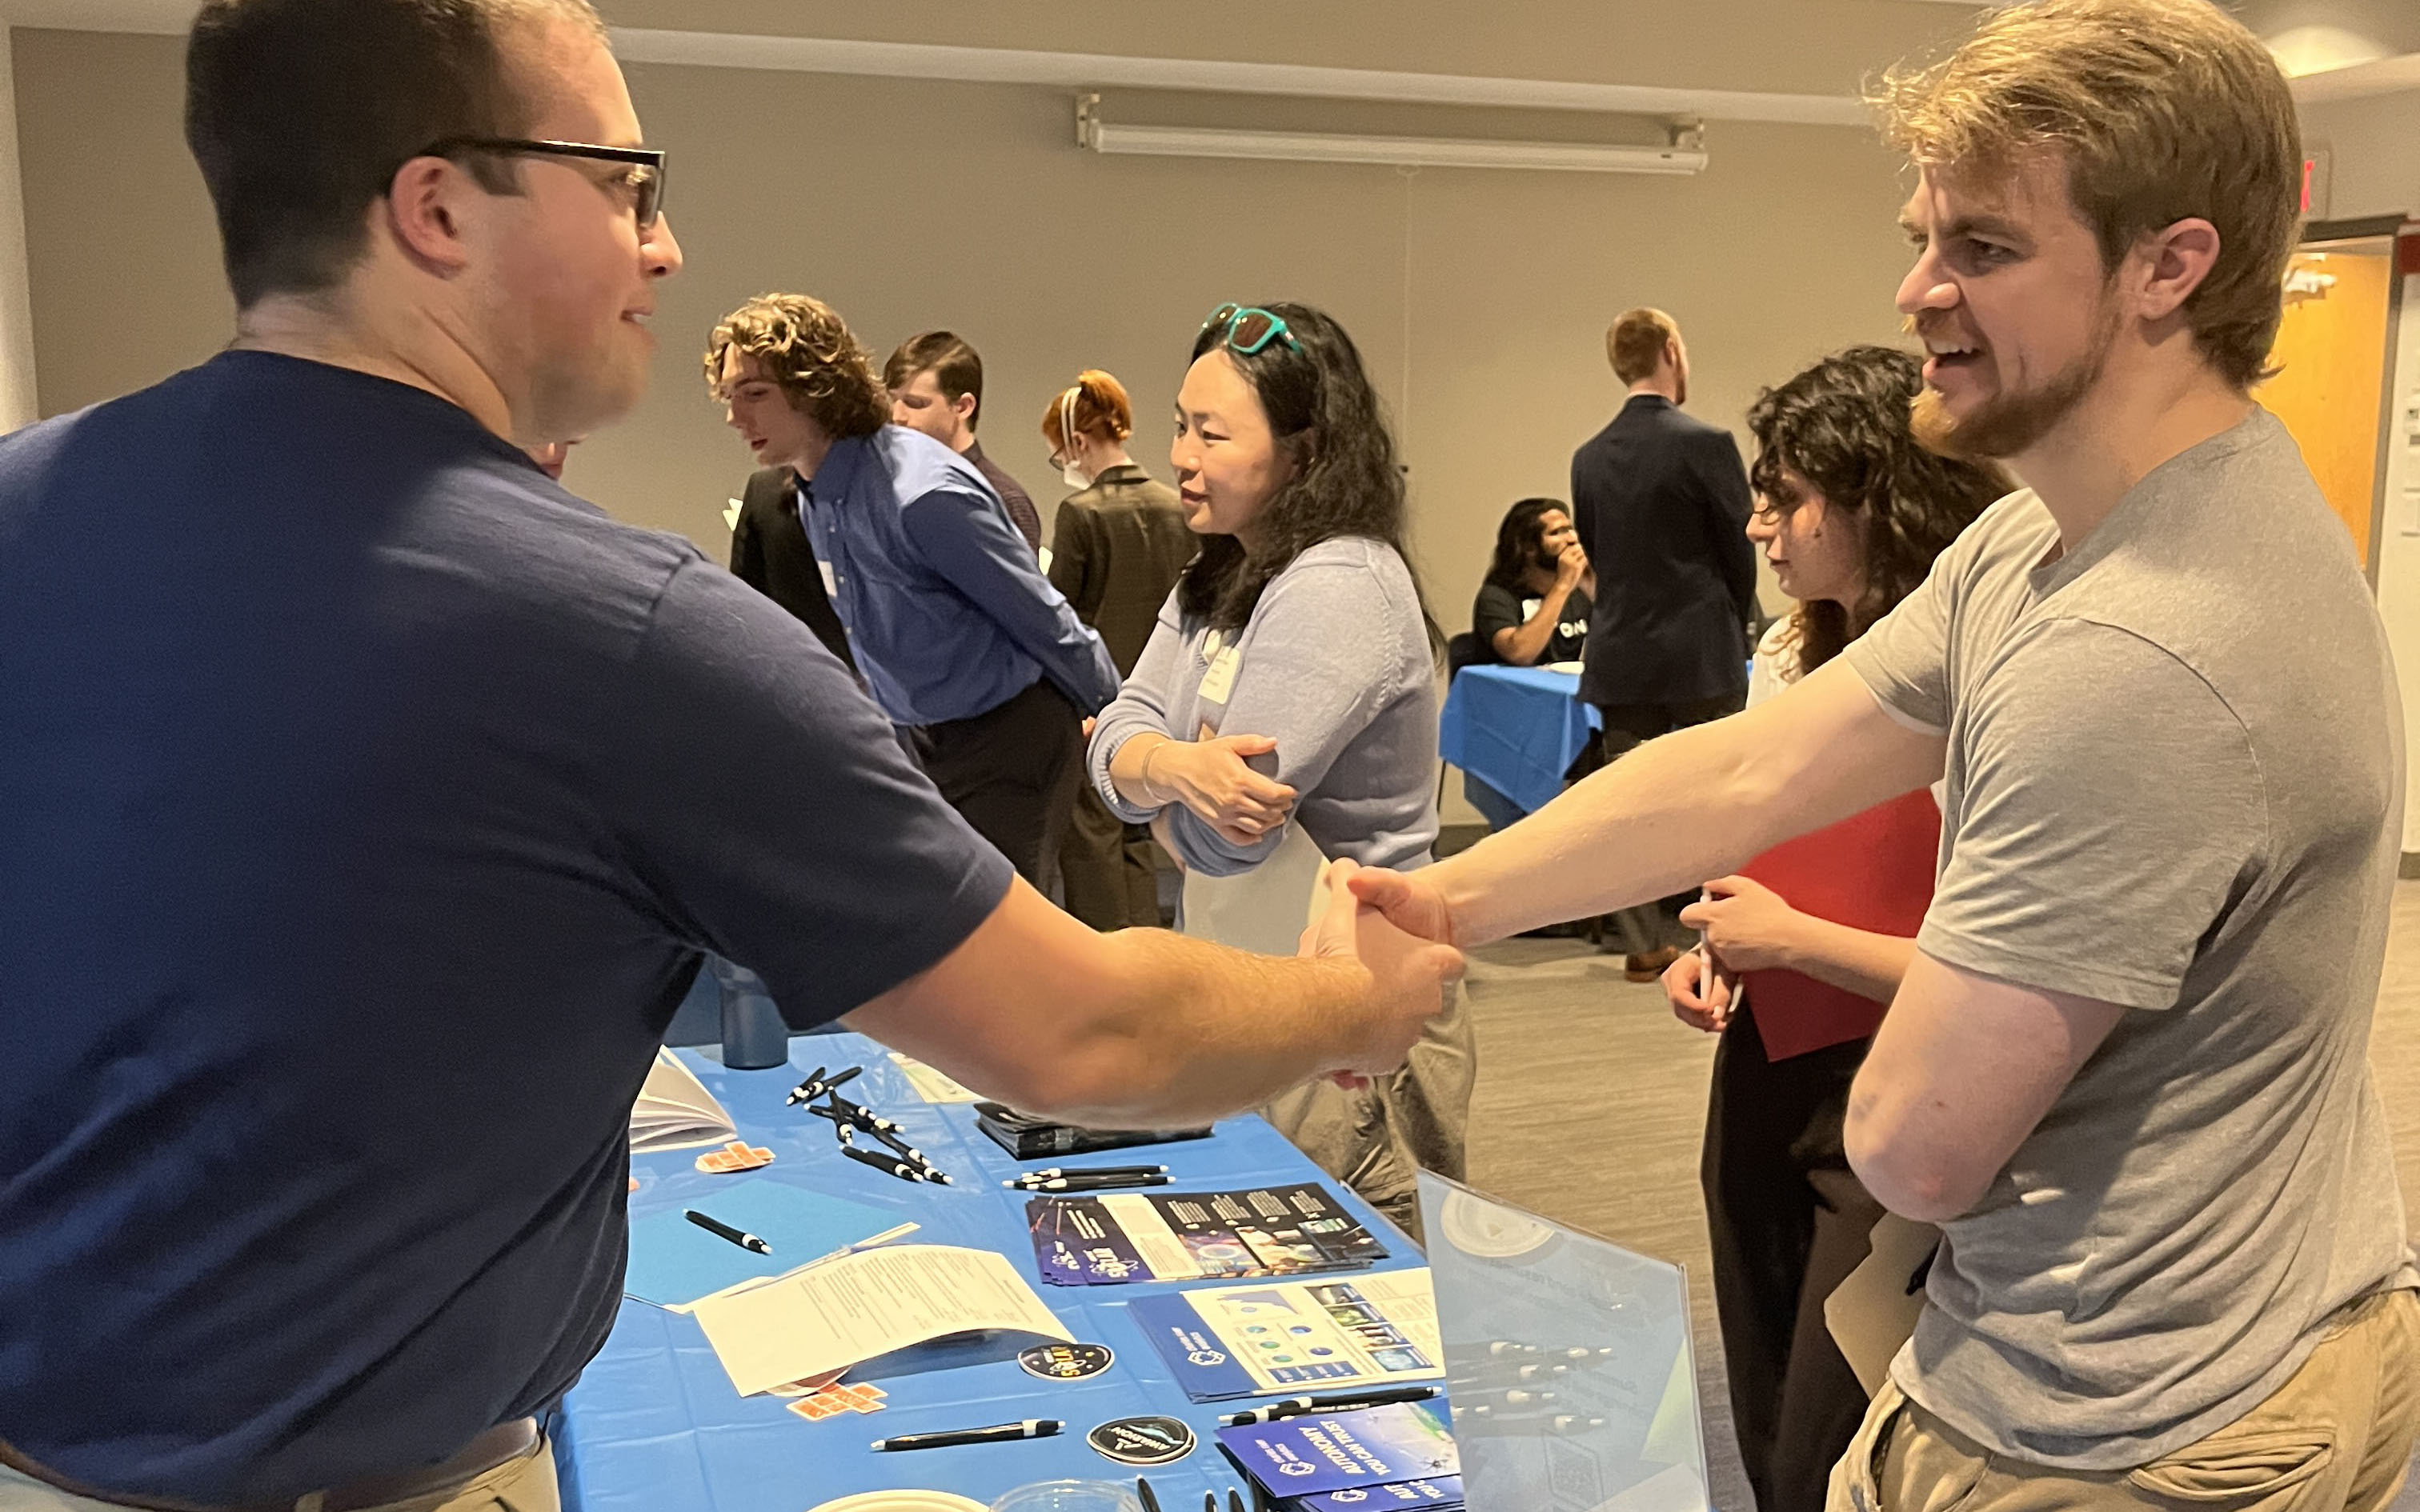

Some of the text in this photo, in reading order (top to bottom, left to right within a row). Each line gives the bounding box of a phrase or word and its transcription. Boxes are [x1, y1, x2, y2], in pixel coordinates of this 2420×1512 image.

[1298, 1427, 1366, 1474] AUTONOMY
[1320, 1420, 1392, 1476] YOU CAN TRUST
[1383, 1484, 1420, 1499] AUT
[1416, 1485, 1445, 1499] YOU
